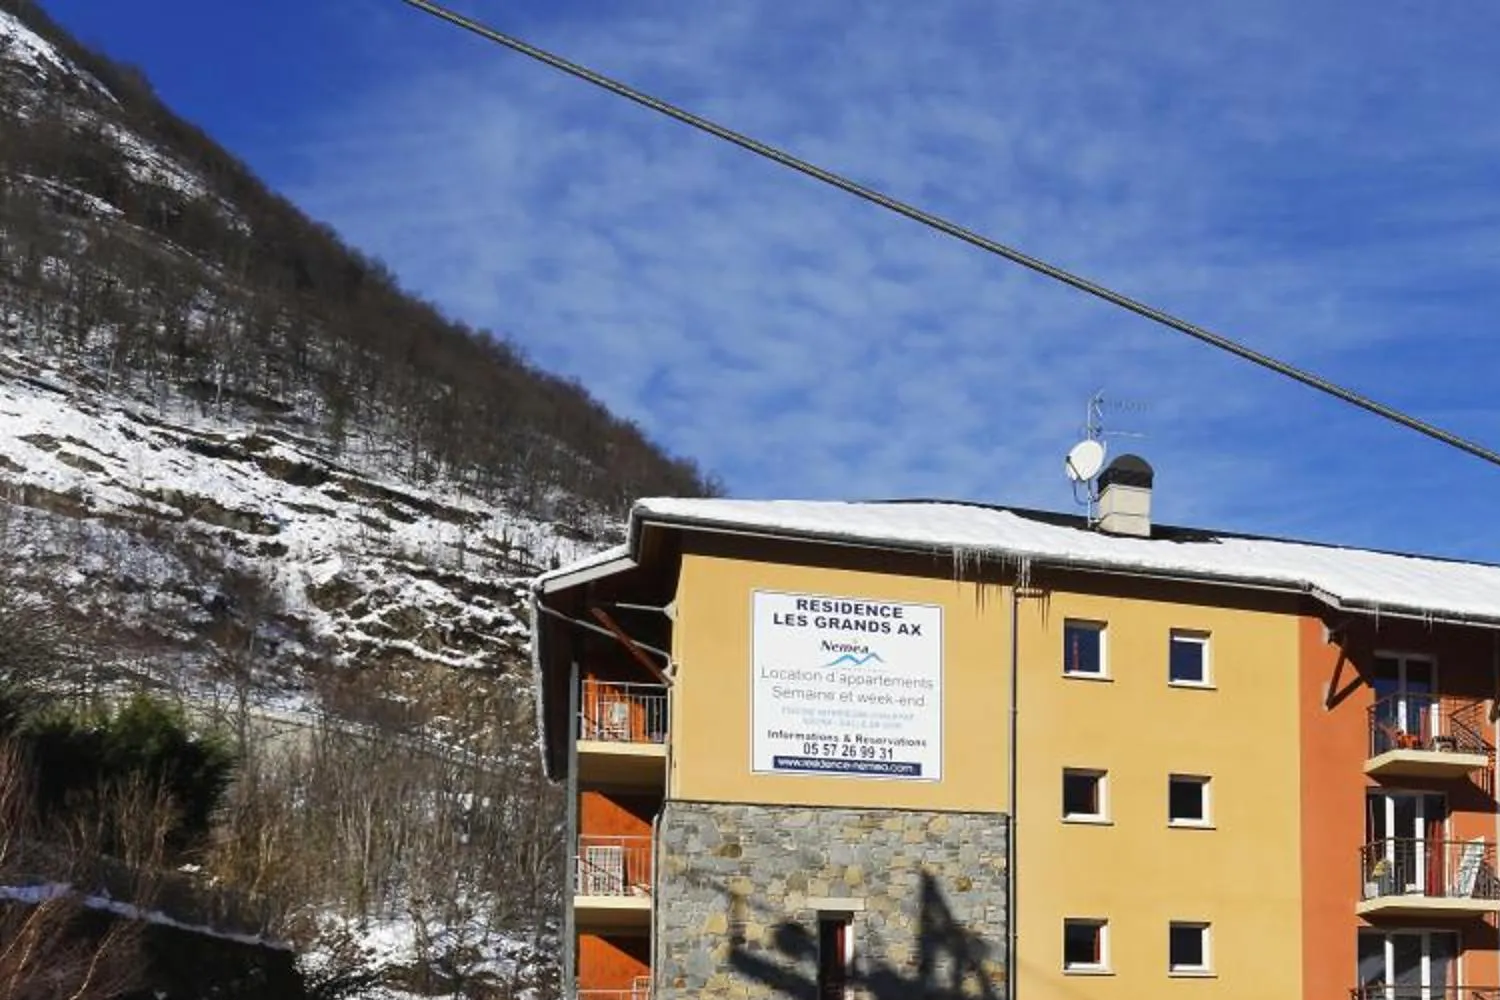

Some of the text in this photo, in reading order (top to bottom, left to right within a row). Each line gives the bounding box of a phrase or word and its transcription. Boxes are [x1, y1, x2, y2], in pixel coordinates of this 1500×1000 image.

[796, 598, 904, 619] RESIDENCE
[773, 613, 923, 636] LES GRANDS AX
[761, 665, 823, 682] Location
[772, 685, 926, 708] Semaine et week-end
[767, 729, 839, 744] Informations
[843, 733, 852, 744] &
[803, 742, 894, 761] 05 57 26 99 31
